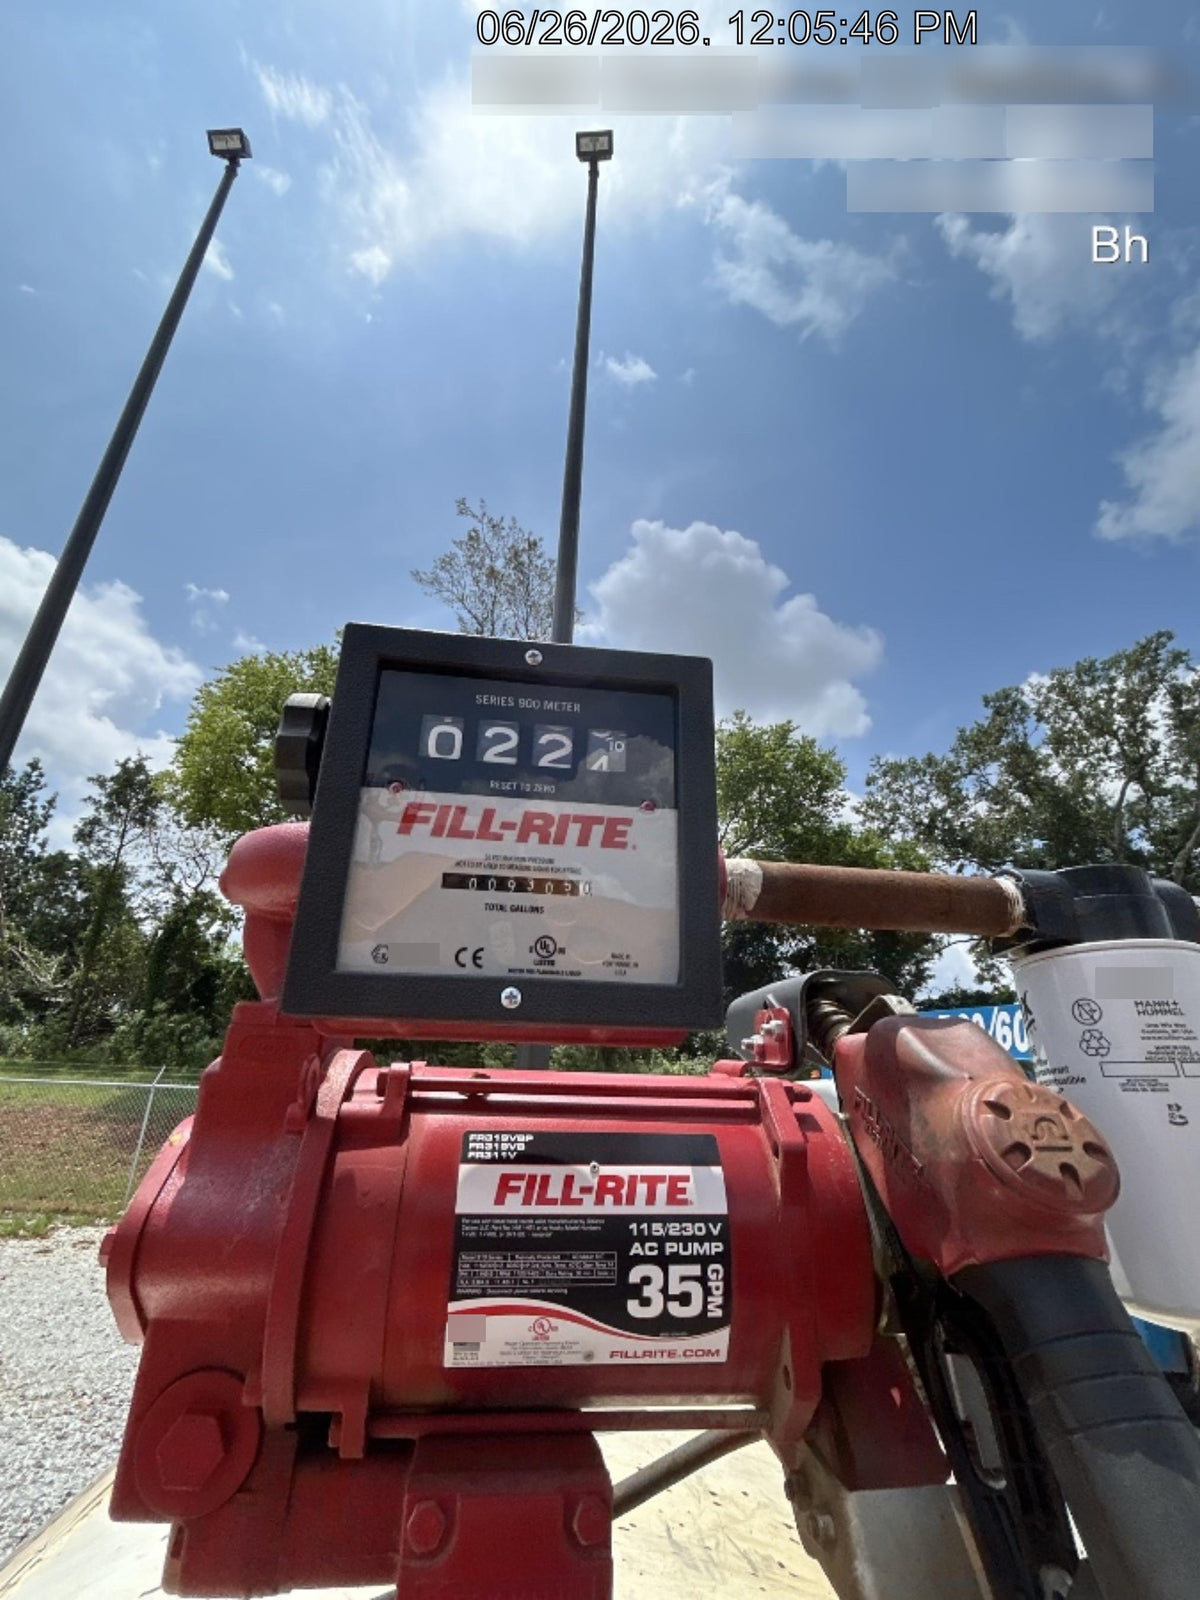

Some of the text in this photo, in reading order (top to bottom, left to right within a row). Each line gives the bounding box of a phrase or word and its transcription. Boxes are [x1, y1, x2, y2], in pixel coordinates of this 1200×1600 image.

[475, 694, 515, 707] SERIES
[543, 699, 581, 713] METER
[397, 802, 634, 849] FILL-RITE
[509, 904, 546, 914] GALLONS
[1137, 1007, 1187, 1017] HUMMEL
[494, 1172, 692, 1207] FILL-RITE
[629, 1242, 724, 1256] AC PUMP
[626, 1263, 704, 1320] 35
[706, 1263, 725, 1319] GPM
[609, 1348, 721, 1360] FILLRITE.COM
